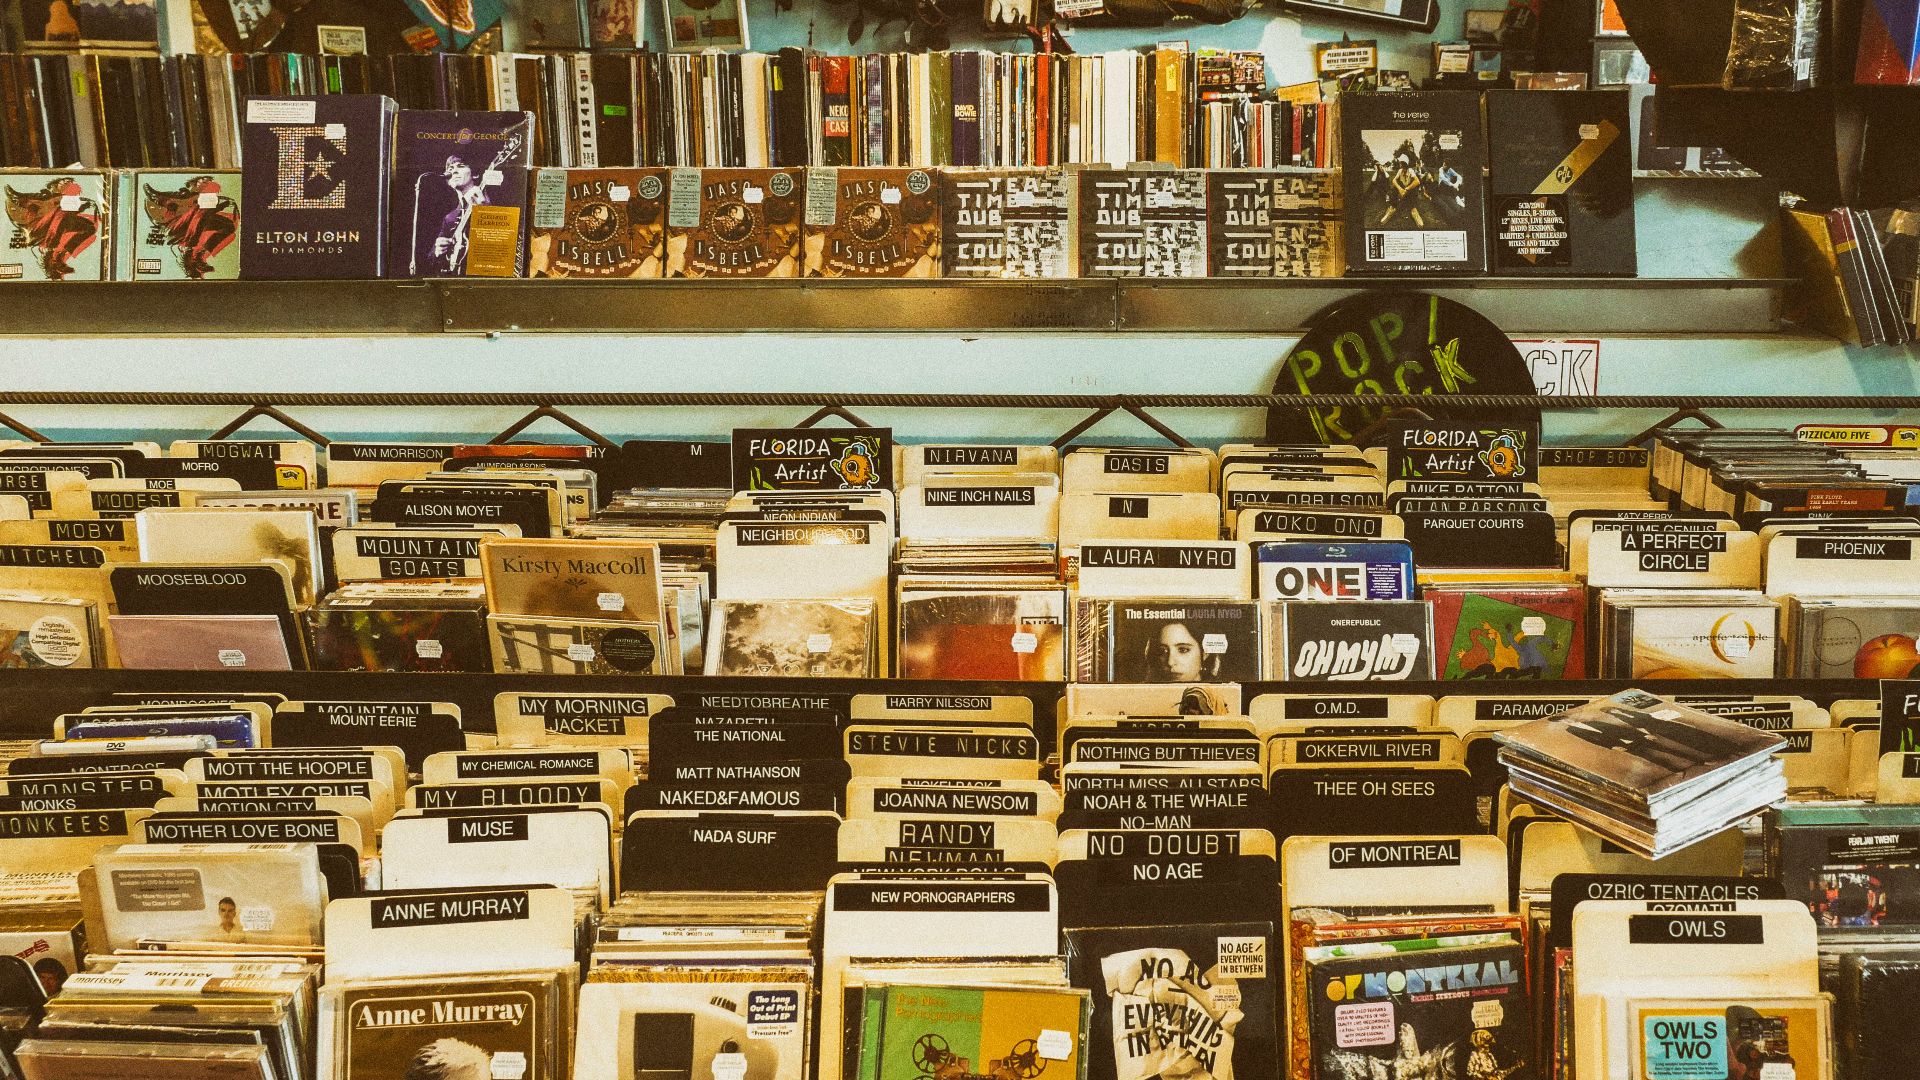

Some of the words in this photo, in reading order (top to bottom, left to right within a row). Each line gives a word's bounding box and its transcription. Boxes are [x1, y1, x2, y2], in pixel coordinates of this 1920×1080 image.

[416, 131, 457, 140] CONCERT
[473, 131, 510, 141] GEORGE
[956, 209, 1003, 226] DUB
[1095, 209, 1141, 226] DUB
[1224, 210, 1270, 226] DUB
[256, 231, 309, 244] ELTON
[313, 230, 361, 244] JOHN
[272, 246, 344, 255] DIAMONDS
[561, 241, 626, 265] ISBELL
[698, 241, 762, 265] ISBELL
[835, 240, 900, 265] ISBELL
[1403, 429, 1479, 447] FLORIDA
[1798, 430, 1848, 440] PIZZICATO
[1849, 430, 1871, 440] FIVE
[203, 444, 274, 459] MOGWAI
[353, 448, 378, 459] VAN
[380, 448, 443, 459] MORRISON
[750, 439, 831, 456] FLORIDA
[930, 449, 1014, 463] NIRVANA
[1425, 453, 1476, 471] Artist
[182, 462, 220, 471] MOFRO
[774, 462, 828, 480] Artist
[1110, 457, 1167, 472] OASIS
[149, 481, 174, 490] MOE
[97, 494, 173, 508] MODEST
[928, 491, 958, 502] NINE
[960, 491, 992, 502] INCH
[995, 490, 1031, 502] NAILS
[405, 504, 453, 516] ALISON
[456, 504, 503, 517] MOYET
[763, 513, 796, 521] NEON
[799, 513, 837, 521] INDIAN
[1263, 515, 1318, 532] YOKO
[1335, 518, 1376, 535] ONO
[1423, 518, 1479, 529] PARQUET
[1482, 518, 1524, 529] COURTS
[56, 524, 116, 539] MOBY
[362, 538, 477, 556] MOUNTAIN
[1624, 534, 1637, 548] A
[1642, 534, 1725, 550] PERFECT
[1824, 543, 1886, 554] PHOENIX
[1088, 550, 1155, 566] LAURA
[1180, 551, 1232, 566] NYRO
[1641, 554, 1707, 570] CIRCLE
[389, 560, 460, 576] GOATS
[501, 555, 562, 580] Kirsty
[566, 556, 647, 576] MacColl
[137, 573, 247, 586] MOOSEBLOOD
[1275, 567, 1361, 597] ONE
[1125, 608, 1143, 619] The
[1143, 608, 1186, 619] Essential
[1186, 608, 1216, 619] LAURA
[1217, 608, 1243, 619] NYRO
[521, 699, 548, 713] MY
[555, 699, 646, 715] MORNING
[701, 696, 830, 709] NEEDTOBREATHE
[890, 698, 933, 708] HARRY
[935, 698, 989, 708] NILSSON
[1315, 703, 1361, 715] O.M.D.
[330, 714, 376, 726] MOUNT
[379, 715, 417, 727] EERIE
[550, 718, 620, 733] JACKET
[694, 731, 719, 742] THE
[723, 731, 786, 742] NATIONAL
[853, 734, 937, 753] STEVIE
[956, 737, 1027, 755] NICKS
[1305, 744, 1382, 758] OKKERVIL
[1386, 743, 1432, 757] RIVER
[1080, 746, 1150, 760] NOTHING
[1155, 746, 1186, 760] BUT
[1190, 747, 1257, 761] THIEVES
[208, 762, 256, 776] MOTT
[260, 762, 294, 775] THE
[299, 761, 367, 775] HOOPLE
[462, 762, 479, 773] MY
[482, 760, 537, 772] CHEMICAL
[539, 758, 595, 770] ROMANCE
[676, 767, 714, 779] MATT
[716, 767, 801, 778] NATHANSON
[1314, 781, 1358, 796] THEE
[1362, 781, 1386, 796] OH
[1391, 781, 1436, 796] SEES
[424, 790, 458, 808] MY
[481, 786, 589, 806] BLOODY
[659, 790, 800, 806] NAKED&FAMOUS
[880, 793, 948, 808] JOANNA
[952, 794, 1029, 810] NEWSOM
[1083, 795, 1131, 810] NOAH
[1151, 794, 1185, 809] THE
[1189, 793, 1249, 808] WHALE
[21, 799, 77, 811] MONKS
[149, 824, 227, 839] MOTHER
[231, 824, 281, 838] LOVE
[285, 823, 335, 838] BONE
[461, 821, 514, 837] MUSE
[690, 829, 733, 843] NADA
[737, 830, 777, 844] SURF
[902, 824, 992, 844] RANDY
[1091, 834, 1125, 856] NO
[1148, 834, 1238, 856] DOUBT
[1874, 834, 1900, 844] TWENTY
[1331, 848, 1356, 864] OF
[1361, 845, 1459, 863] MONTREAL
[1133, 864, 1161, 881] NO
[1165, 862, 1204, 880] AGE
[871, 892, 900, 903] NEW
[903, 891, 1016, 904] PORNOGRAPHERS
[1588, 883, 1645, 900] OZRIC
[1650, 884, 1760, 901] TENTACLES
[381, 902, 436, 922] ANNE
[441, 896, 526, 918] MURRAY
[1668, 920, 1727, 938] OWLS
[1220, 943, 1233, 954] NO
[1235, 943, 1253, 953] AGE
[1220, 954, 1264, 964] EVERYTHING
[143, 970, 213, 978] Morrissey
[1220, 965, 1229, 973] IN
[1229, 965, 1264, 974] BETWEEN
[74, 977, 126, 986] morrissey
[749, 1004, 765, 1012] Out
[776, 1003, 797, 1012] Print
[771, 995, 791, 1006] Long
[356, 1004, 426, 1028] Anne
[431, 1000, 529, 1026] Murray
[754, 1013, 780, 1021] Debut
[781, 1012, 791, 1020] EP
[1653, 1020, 1718, 1041] OWLS
[1659, 1041, 1713, 1060] TWO
